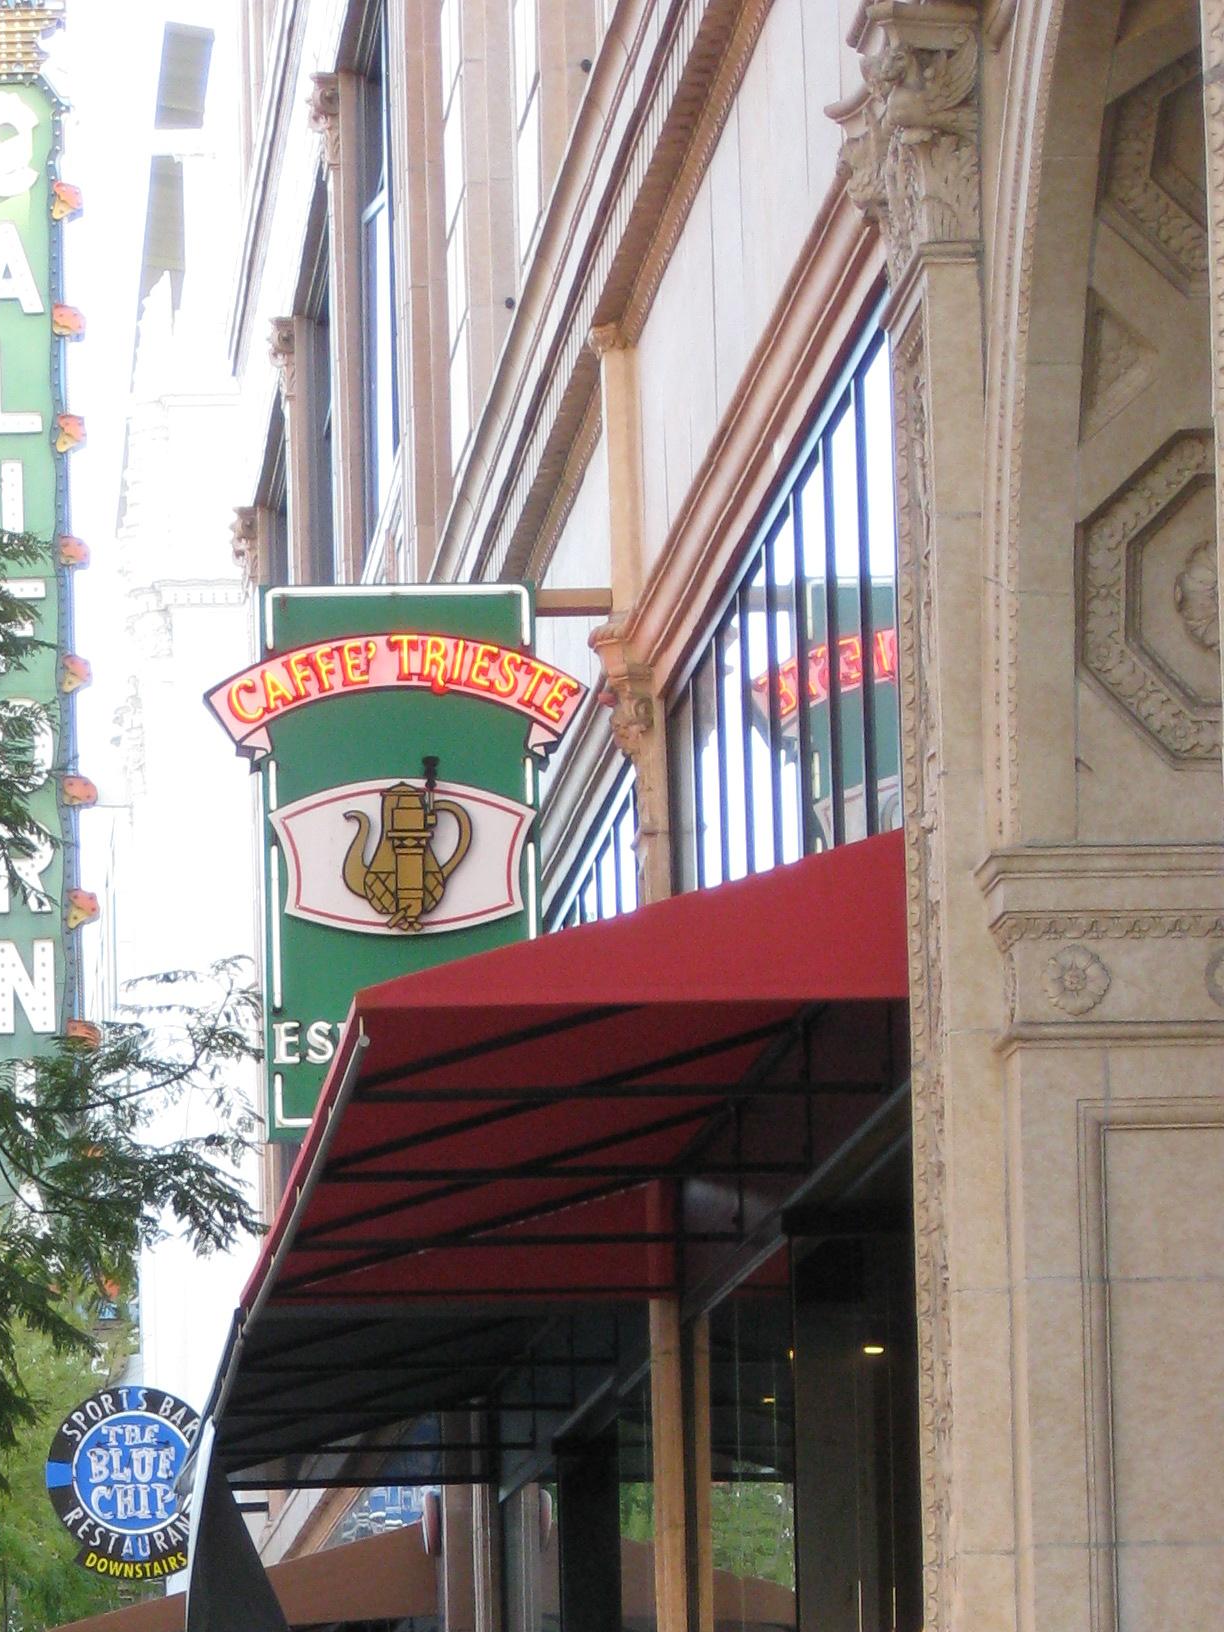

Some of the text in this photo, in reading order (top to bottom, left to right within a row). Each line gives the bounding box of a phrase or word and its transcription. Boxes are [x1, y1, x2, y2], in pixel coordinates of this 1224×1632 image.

[388, 632, 579, 724] TRIESTE
[62, 1389, 149, 1442] SPORTS
[101, 1424, 160, 1446] THE
[87, 1449, 176, 1483] BLUE
[91, 1483, 177, 1520] CHIP
[62, 1505, 193, 1557] RESTAURAN
[85, 1552, 188, 1579] DOWNSTAIRS
